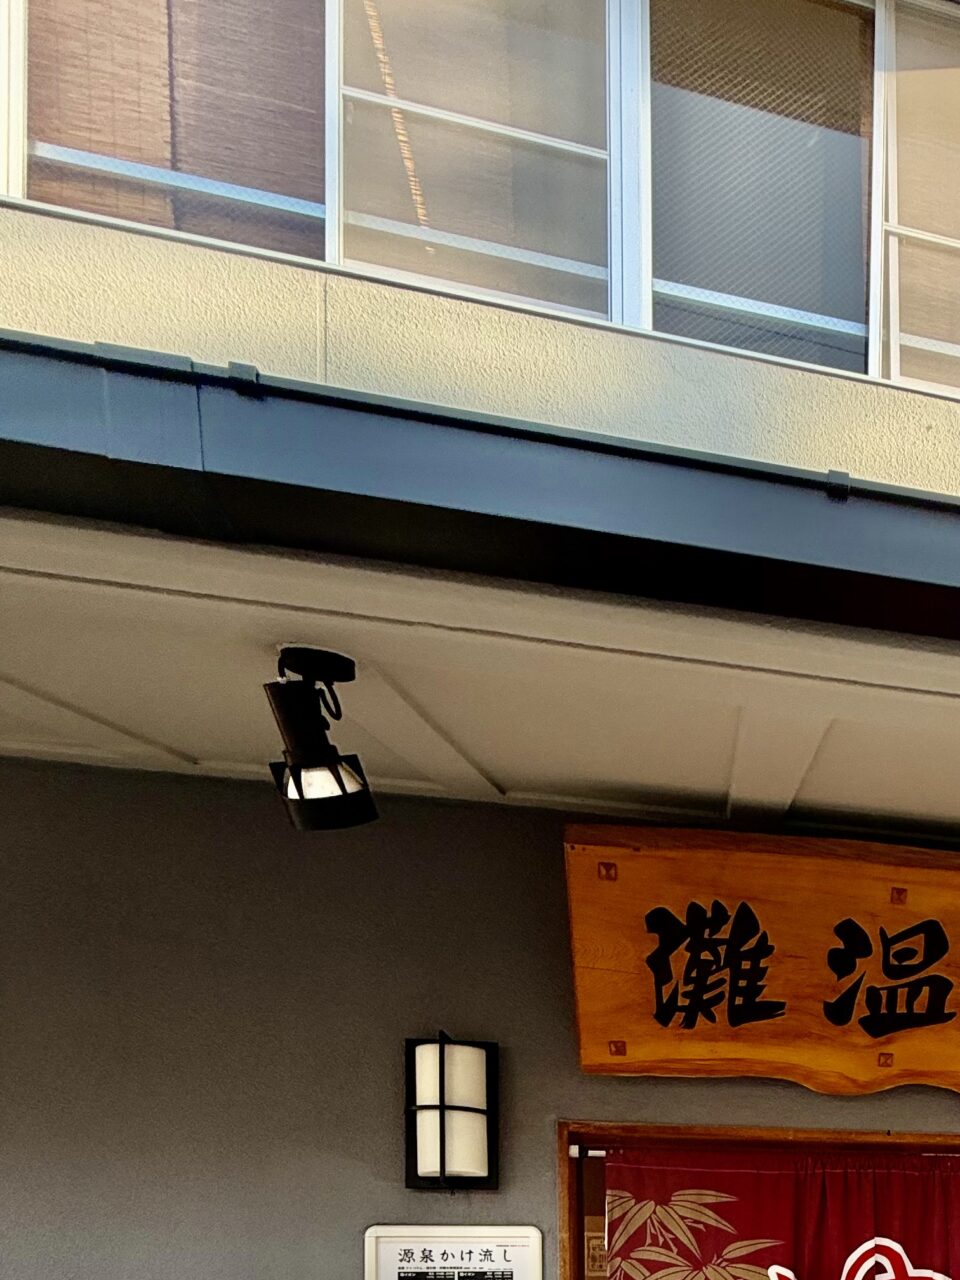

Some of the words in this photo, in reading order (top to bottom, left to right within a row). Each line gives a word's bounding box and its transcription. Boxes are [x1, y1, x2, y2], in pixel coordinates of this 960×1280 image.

[397, 1248, 512, 1263] 源泉かけ流し
